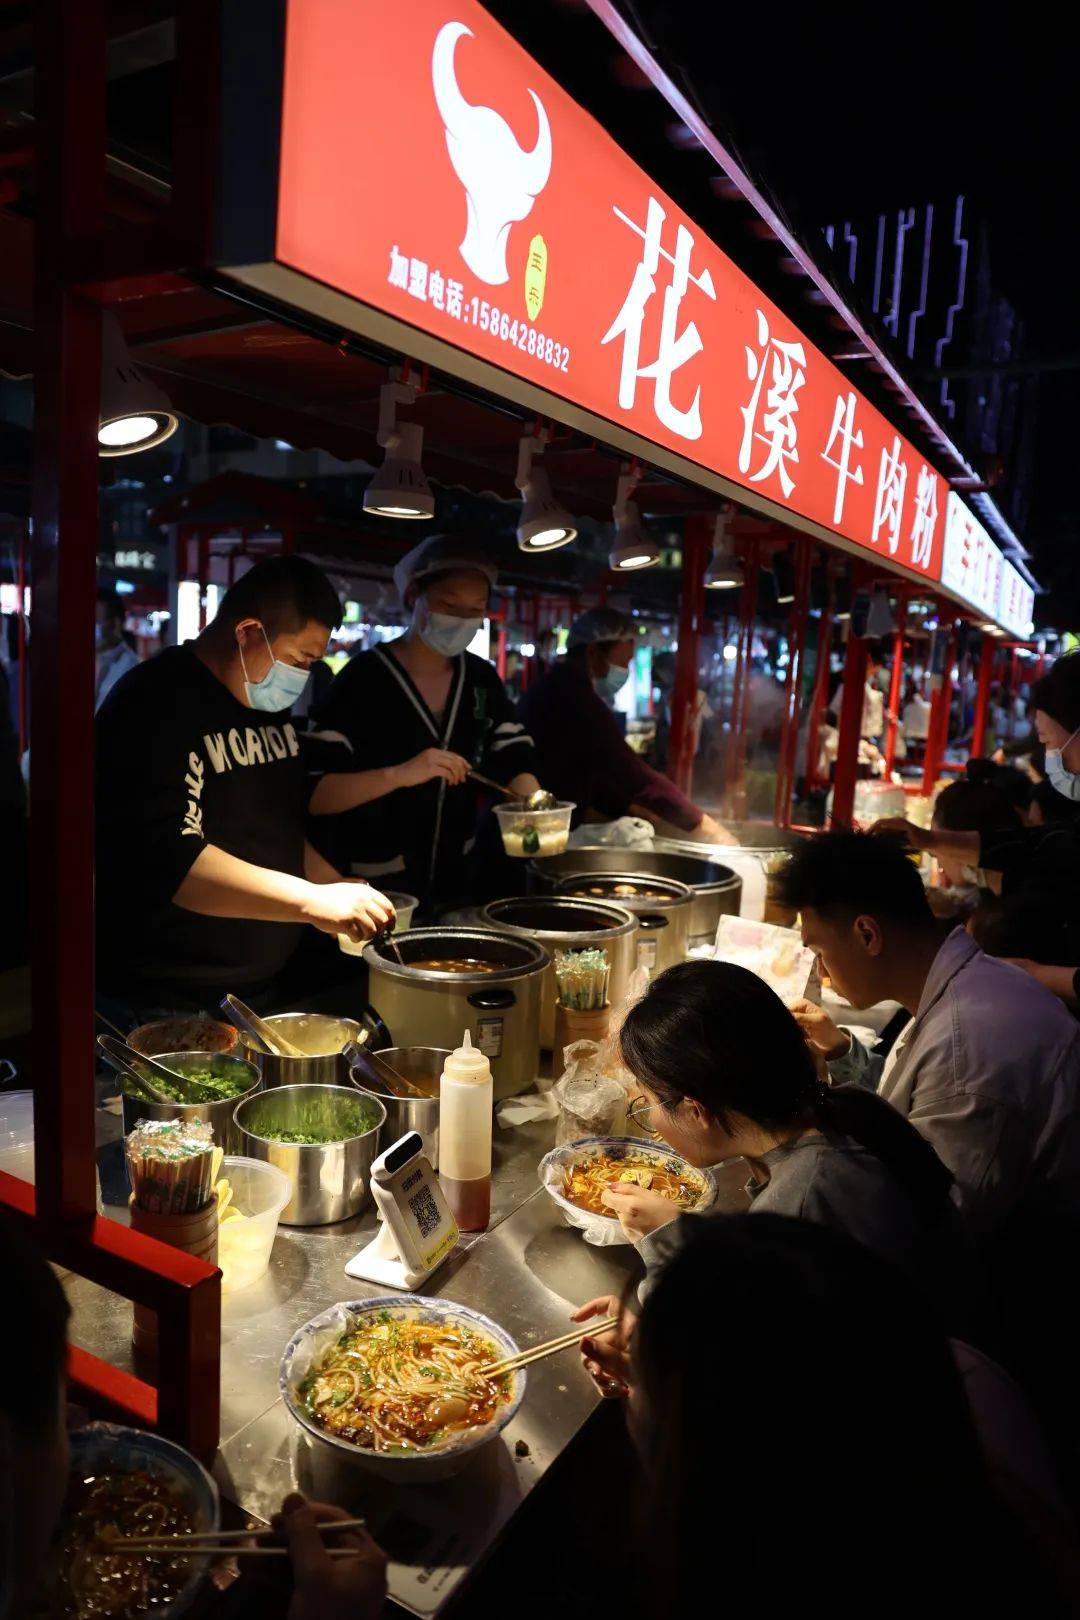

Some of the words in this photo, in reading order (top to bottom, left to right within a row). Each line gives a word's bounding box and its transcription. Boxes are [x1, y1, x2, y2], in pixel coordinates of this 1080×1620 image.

[601, 196, 937, 569] 花溪牛肉粉
